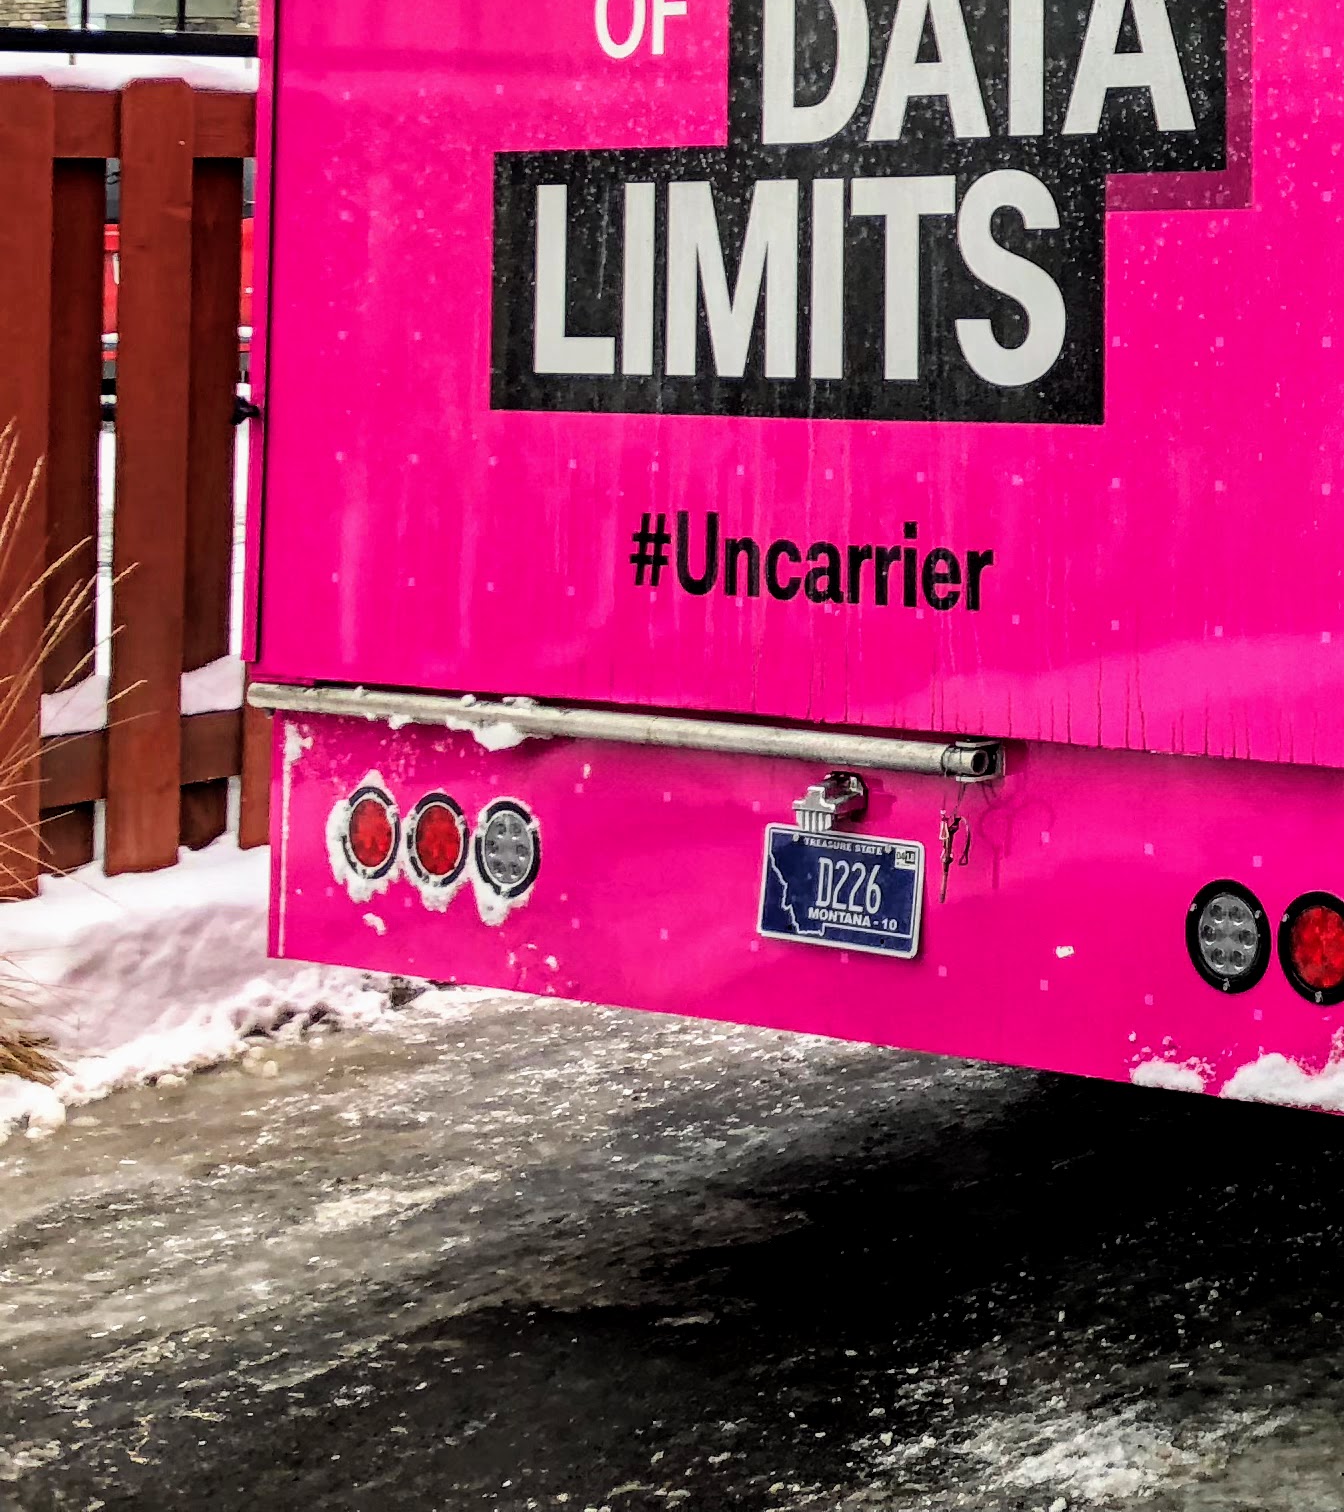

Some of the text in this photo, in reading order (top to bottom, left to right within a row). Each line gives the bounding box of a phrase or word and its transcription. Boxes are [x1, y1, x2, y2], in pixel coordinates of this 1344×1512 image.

[532, 168, 1067, 388] LIMITS
[630, 510, 994, 613] #Uncarrier
[804, 837, 882, 855] TREASURE STATE
[815, 857, 882, 914] D226
[808, 908, 898, 931] MONTANA 10
